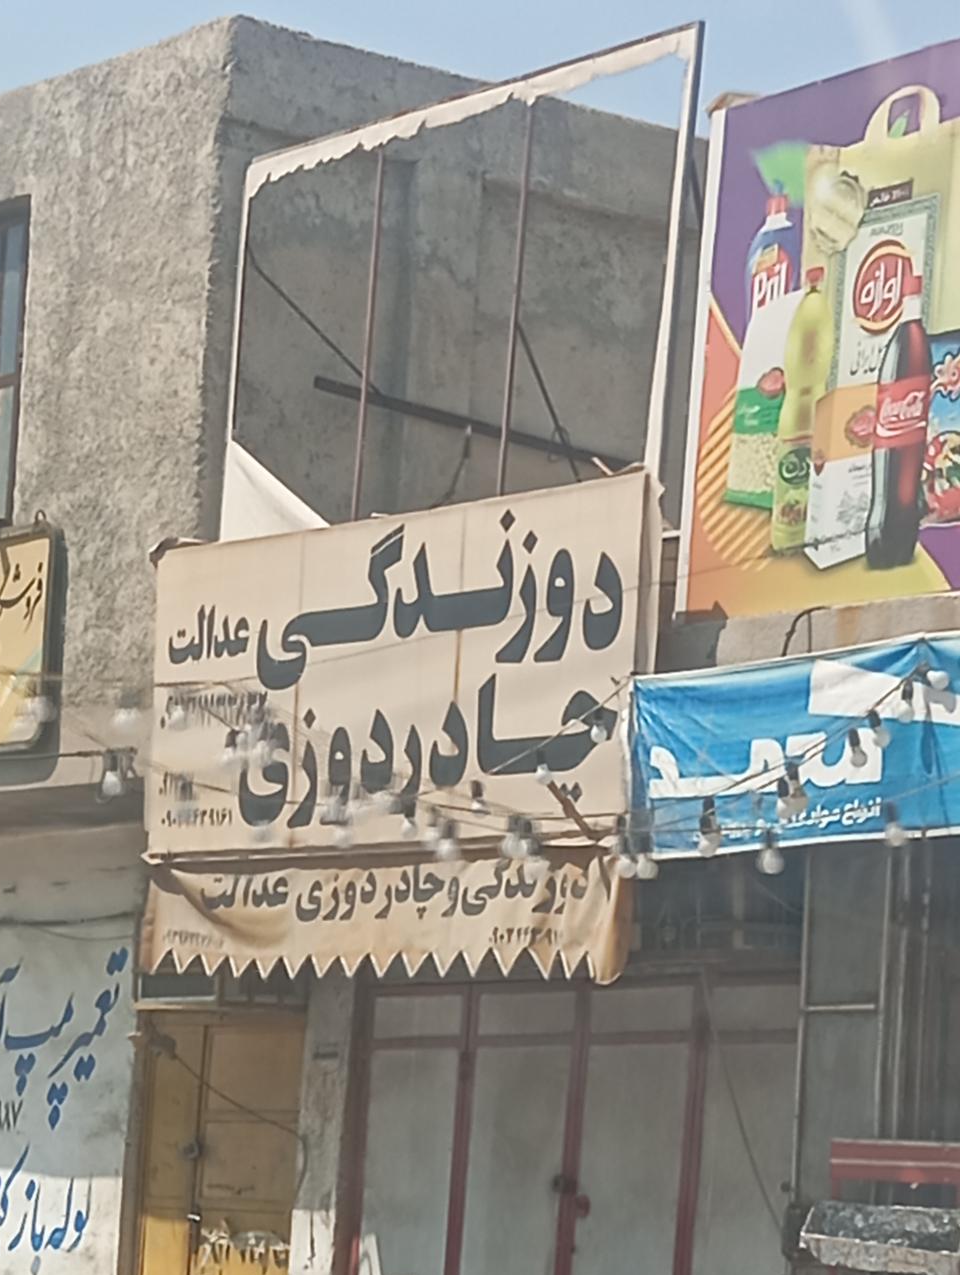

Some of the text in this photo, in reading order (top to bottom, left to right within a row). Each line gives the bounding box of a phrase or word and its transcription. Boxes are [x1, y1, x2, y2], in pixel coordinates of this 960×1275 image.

[168, 509, 623, 691] دوزندگی عدالت
[200, 875, 290, 912] عدالت
[4, 991, 75, 1131] پمپ
[47, 947, 128, 1082] تعمیر
[44, 1174, 92, 1253] لوله
